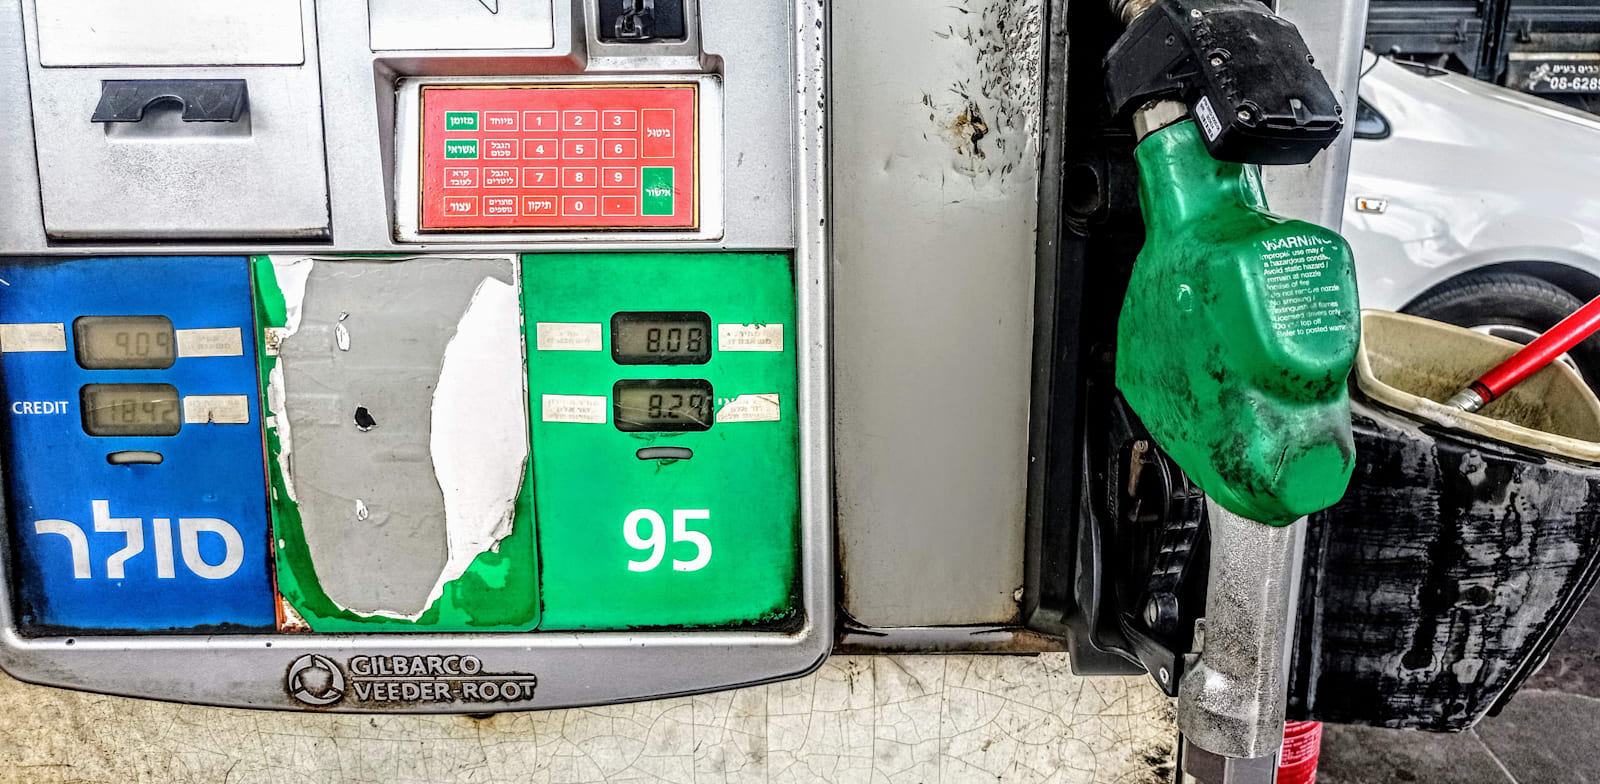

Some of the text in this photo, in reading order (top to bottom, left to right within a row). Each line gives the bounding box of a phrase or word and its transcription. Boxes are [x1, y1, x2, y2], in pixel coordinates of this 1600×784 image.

[1550, 77, 1600, 90] 08-628
[450, 116, 474, 127] מזומן
[489, 117, 514, 125] מיוחד
[536, 116, 542, 126] 1
[574, 116, 583, 126] 2
[613, 116, 622, 126] 3
[646, 127, 671, 138] ביטול
[448, 145, 476, 154] אשראי
[535, 144, 544, 154] 4
[575, 144, 584, 154] 5
[614, 144, 623, 154] 6
[452, 169, 469, 177] קרא
[491, 169, 510, 177] הגבל
[535, 172, 544, 182] 7
[575, 172, 584, 182] 8
[614, 172, 623, 182] 9
[487, 177, 514, 185] ליטרים
[645, 188, 671, 197] אישור
[450, 202, 471, 212] עצור
[528, 200, 552, 212] תיקון
[574, 201, 583, 211] 0
[1305, 247, 1319, 255] may
[1270, 257, 1305, 267] hazardous
[1263, 267, 1283, 275] Avoid
[1284, 265, 1302, 273] static
[1303, 262, 1325, 270] hazard
[1267, 275, 1291, 283] remain
[1301, 270, 1322, 278] nozzle
[1320, 284, 1339, 292] nozzle
[1328, 308, 1341, 316] only
[1305, 325, 1328, 335] posted
[116, 331, 170, 357] 9.09
[646, 327, 703, 353] 8.08
[12, 401, 69, 415] CREDIT
[34, 499, 245, 580] סולר
[622, 508, 713, 572] 95
[351, 655, 482, 676] GILBARCO
[352, 681, 536, 701] VEEDER-ROOT
